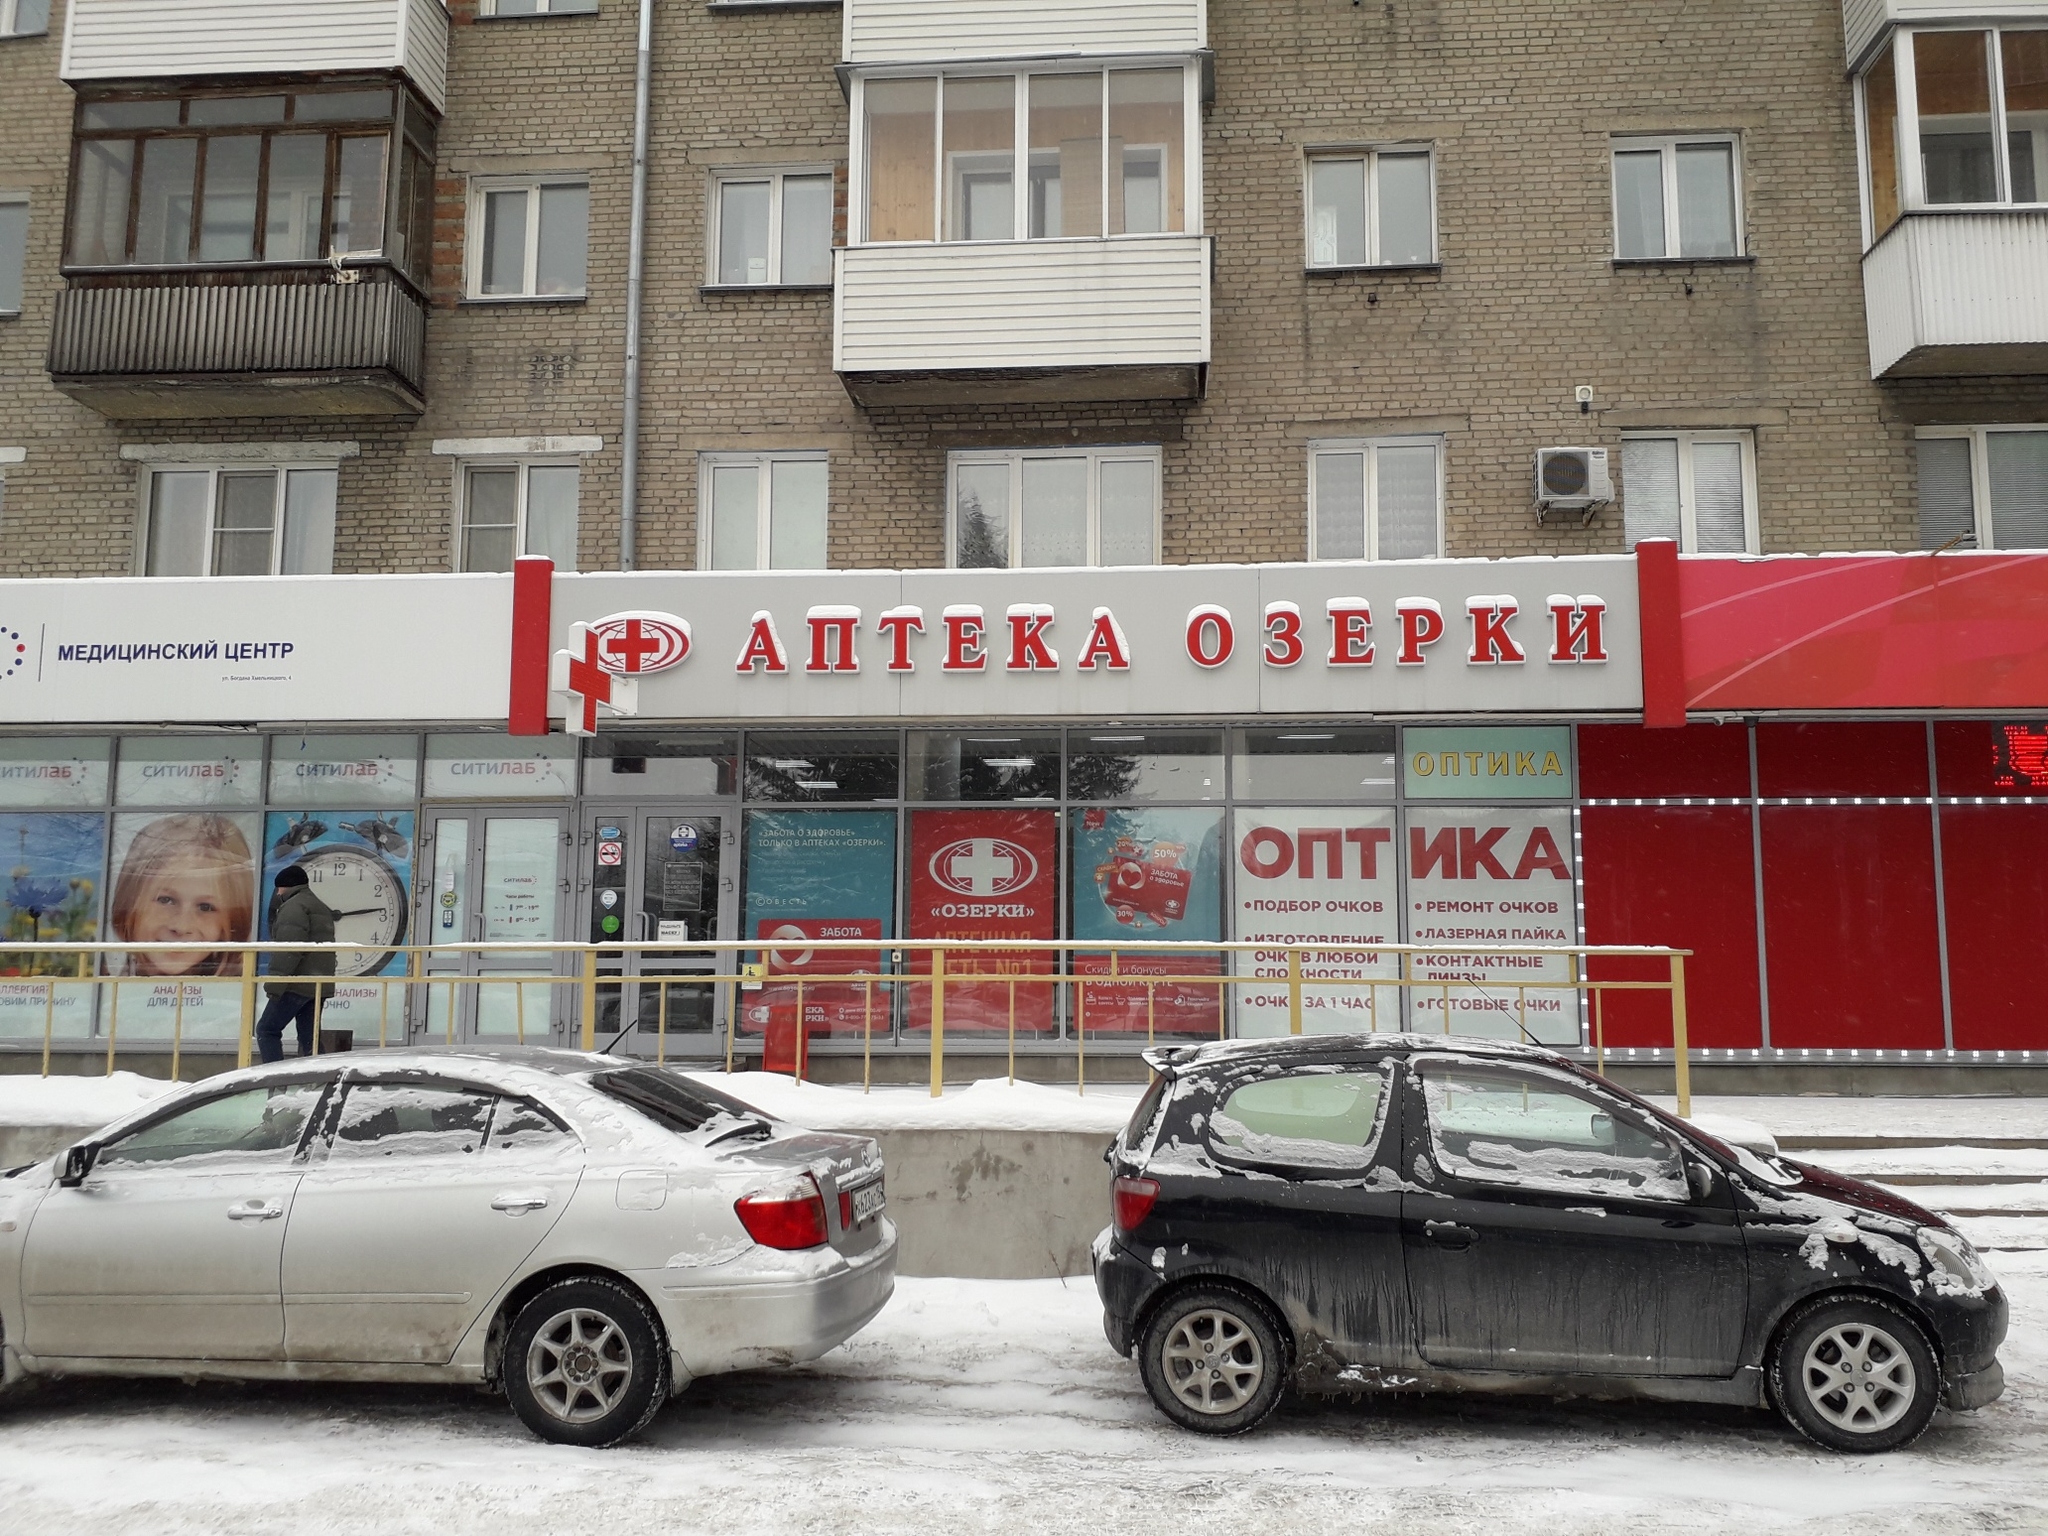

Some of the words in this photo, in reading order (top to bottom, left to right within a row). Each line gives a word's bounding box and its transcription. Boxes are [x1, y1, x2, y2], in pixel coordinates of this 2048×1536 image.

[736, 606, 1131, 674] АПТЕКА
[1185, 602, 1608, 669] ОЗЕРКИ
[58, 640, 218, 663] МЕДИЦИНСКИЙ
[224, 643, 294, 662] ЦЕНТР
[1413, 751, 1564, 776] ОПТИКА
[0, 765, 72, 778] итилаб
[759, 839, 792, 847] ТОЛЬКО
[795, 839, 800, 847] В
[802, 839, 840, 847] АПТЕКАХ
[1154, 849, 1177, 858] 50%
[333, 863, 346, 876] 12
[358, 869, 364, 881] 1
[1151, 869, 1178, 879] ЗАБОТА
[312, 870, 323, 882] 11
[374, 885, 382, 897] 2
[931, 904, 1035, 918] «ОЗЕРКИ»
[1254, 900, 1321, 913] ПОДБОР
[1326, 900, 1384, 913] ОЧКОВ
[1426, 902, 1494, 913] РЕМОНТ
[1499, 902, 1558, 914] ОЧКОВ
[379, 908, 387, 922] 3
[1116, 910, 1133, 918] 30%
[370, 931, 379, 944] 4
[820, 927, 862, 937] ЗАБОТА
[1425, 928, 1507, 939] ЛАЗЕРНАЯ
[1512, 926, 1567, 940] ПАЙКА
[1254, 934, 1384, 945] ИЗГОТОВЛЕНИЕ
[1254, 951, 1311, 962] ОЧКВ
[1426, 955, 1543, 968] КОНТАКТНЫЕ
[946, 959, 985, 982] ЕТЬ
[1131, 965, 1166, 976] бонусы
[1254, 967, 1362, 978] СЛОНОСТИ
[0, 985, 49, 994] ЛЛЕРГИЯ?
[334, 988, 377, 998] НАЛИЗЫ
[147, 997, 168, 1007] ДЛЯ
[322, 1000, 350, 1009] ОЧНО
[1255, 995, 1288, 1007] ОЧК
[1305, 996, 1326, 1008] ЗА
[1331, 997, 1336, 1008] 1
[1427, 998, 1509, 1010] ГОТОВЫЕ
[1514, 999, 1560, 1011] ОЧКИ
